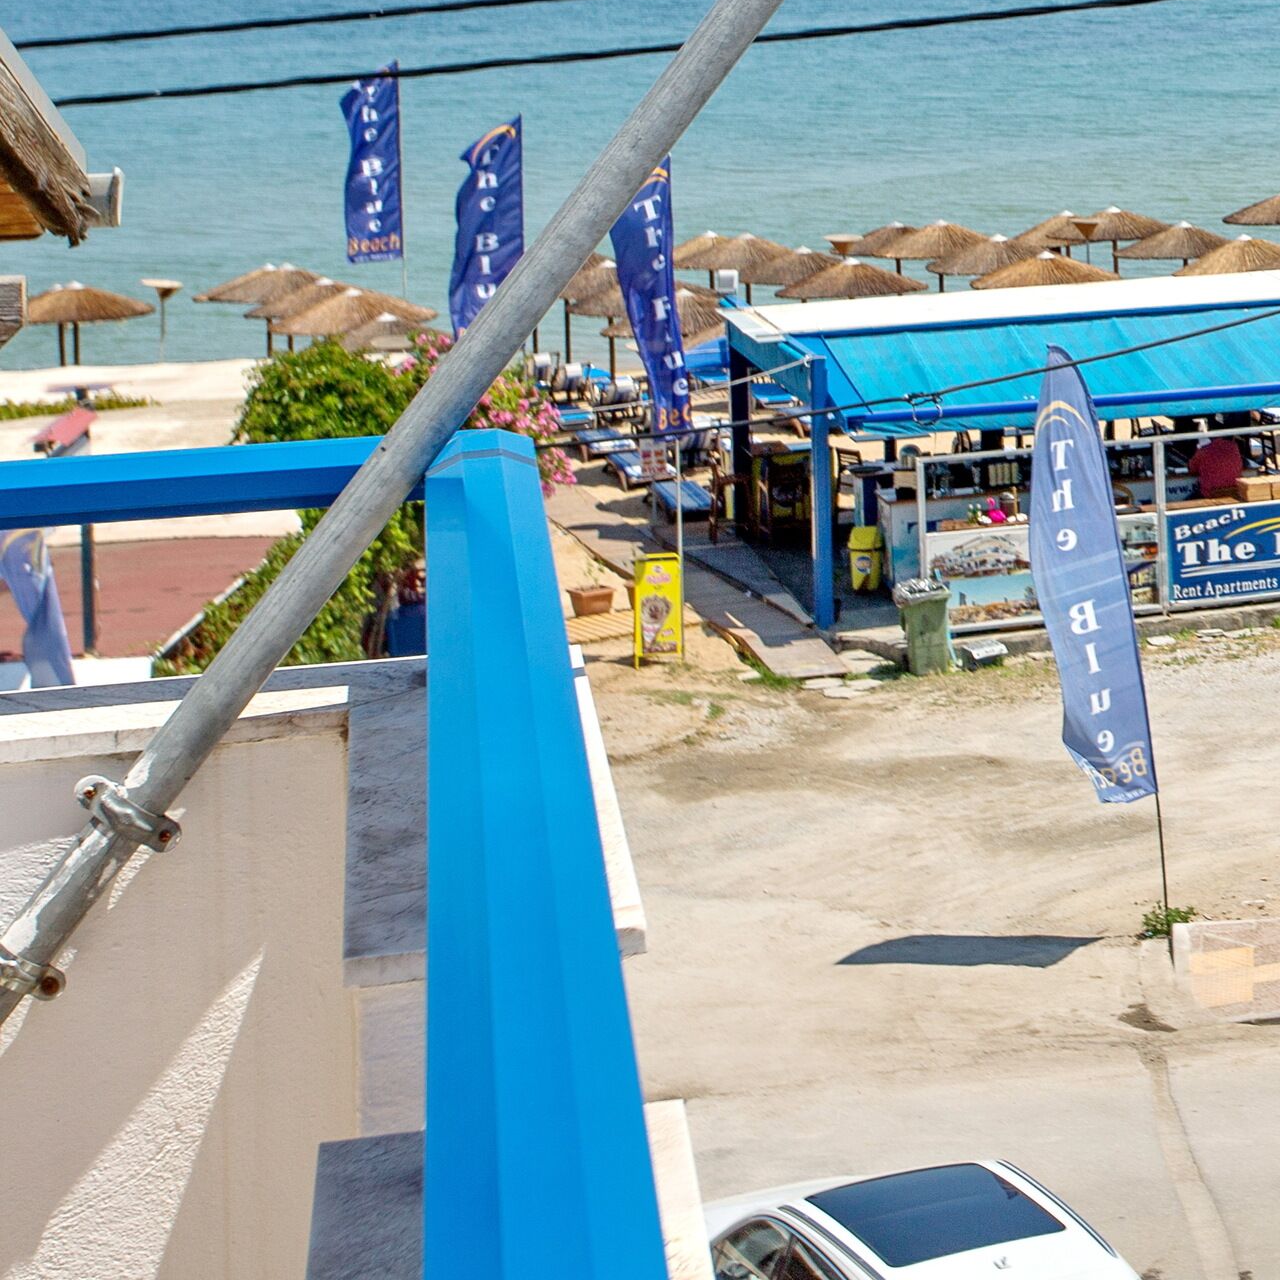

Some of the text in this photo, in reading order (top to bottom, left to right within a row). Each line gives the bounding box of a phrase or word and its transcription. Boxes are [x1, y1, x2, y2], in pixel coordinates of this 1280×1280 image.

[347, 232, 402, 256] Beach
[1173, 507, 1247, 541] Beach
[1176, 538, 1257, 567] The
[1172, 583, 1202, 600] Rent
[1203, 577, 1279, 599] Apartments
